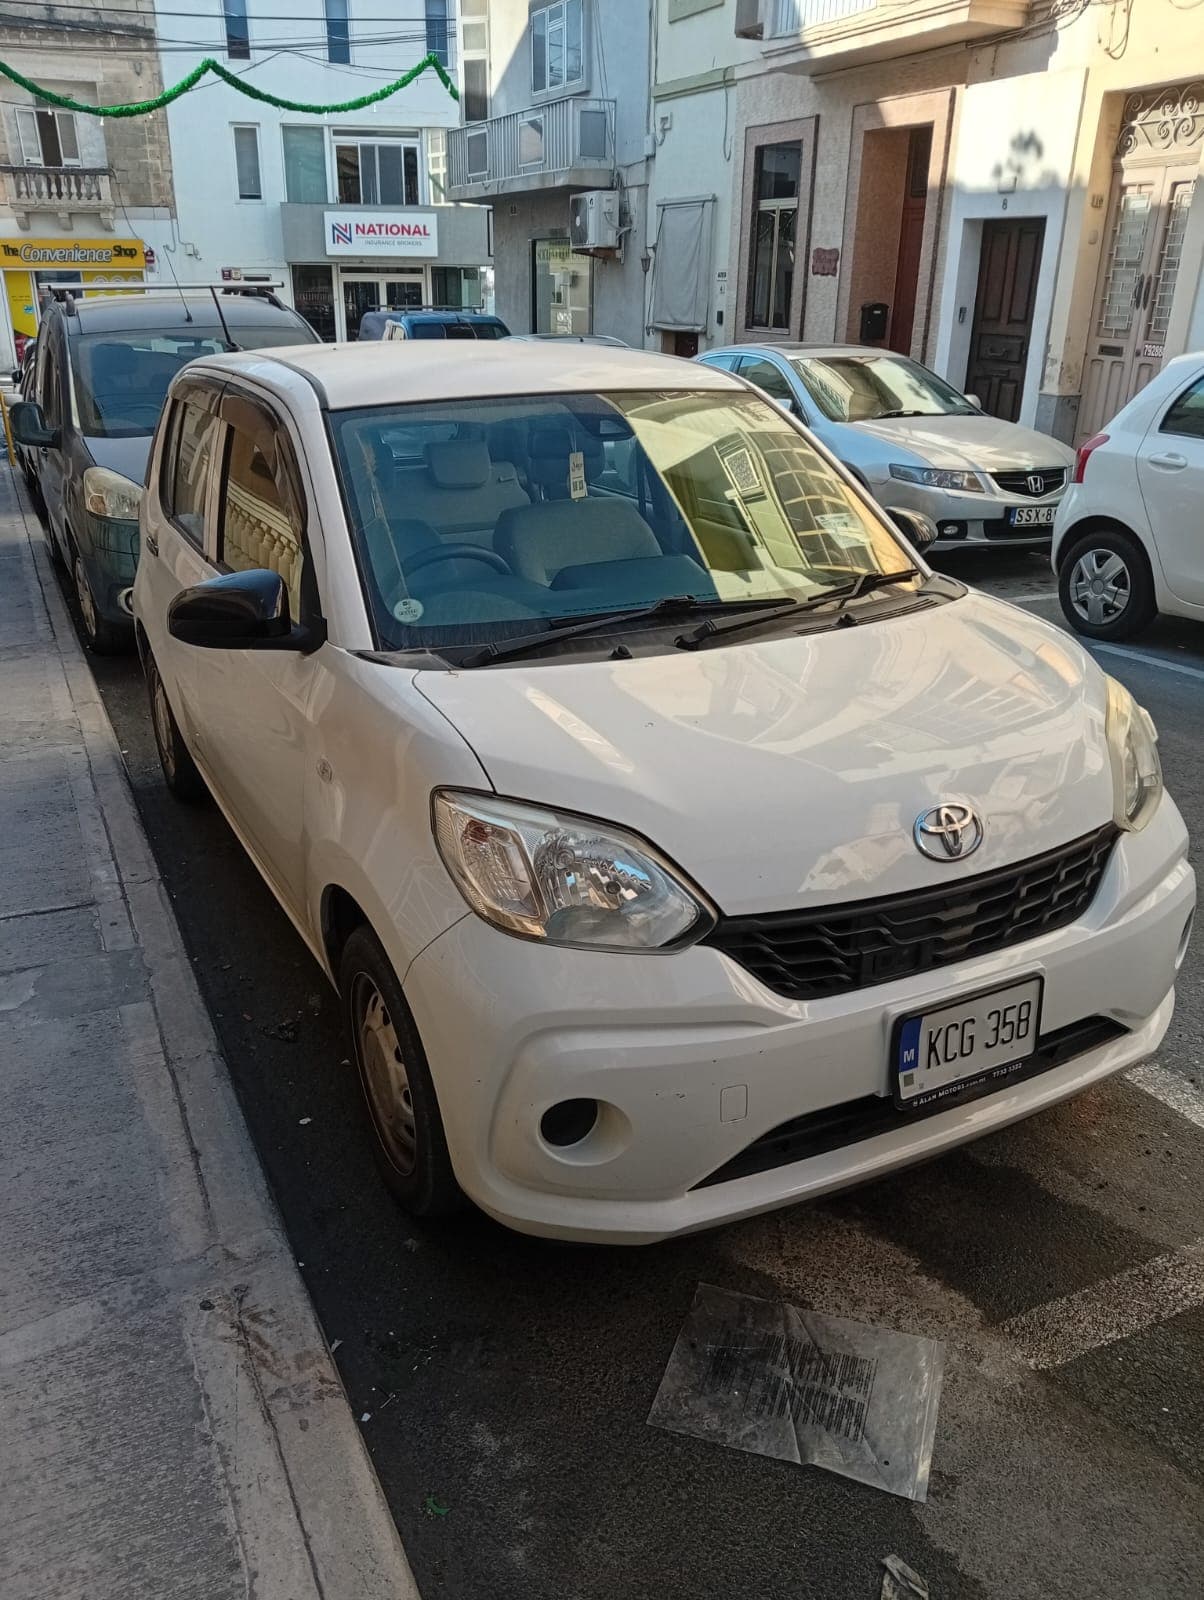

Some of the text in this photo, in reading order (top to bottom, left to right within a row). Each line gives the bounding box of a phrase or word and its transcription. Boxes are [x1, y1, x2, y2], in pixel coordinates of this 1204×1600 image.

[1002, 198, 1008, 210] 8
[355, 223, 430, 236] NATIONAL
[2, 244, 138, 263] The Convenience Shop
[926, 1000, 1032, 1070] KCG 358
[903, 1049, 915, 1063] M
